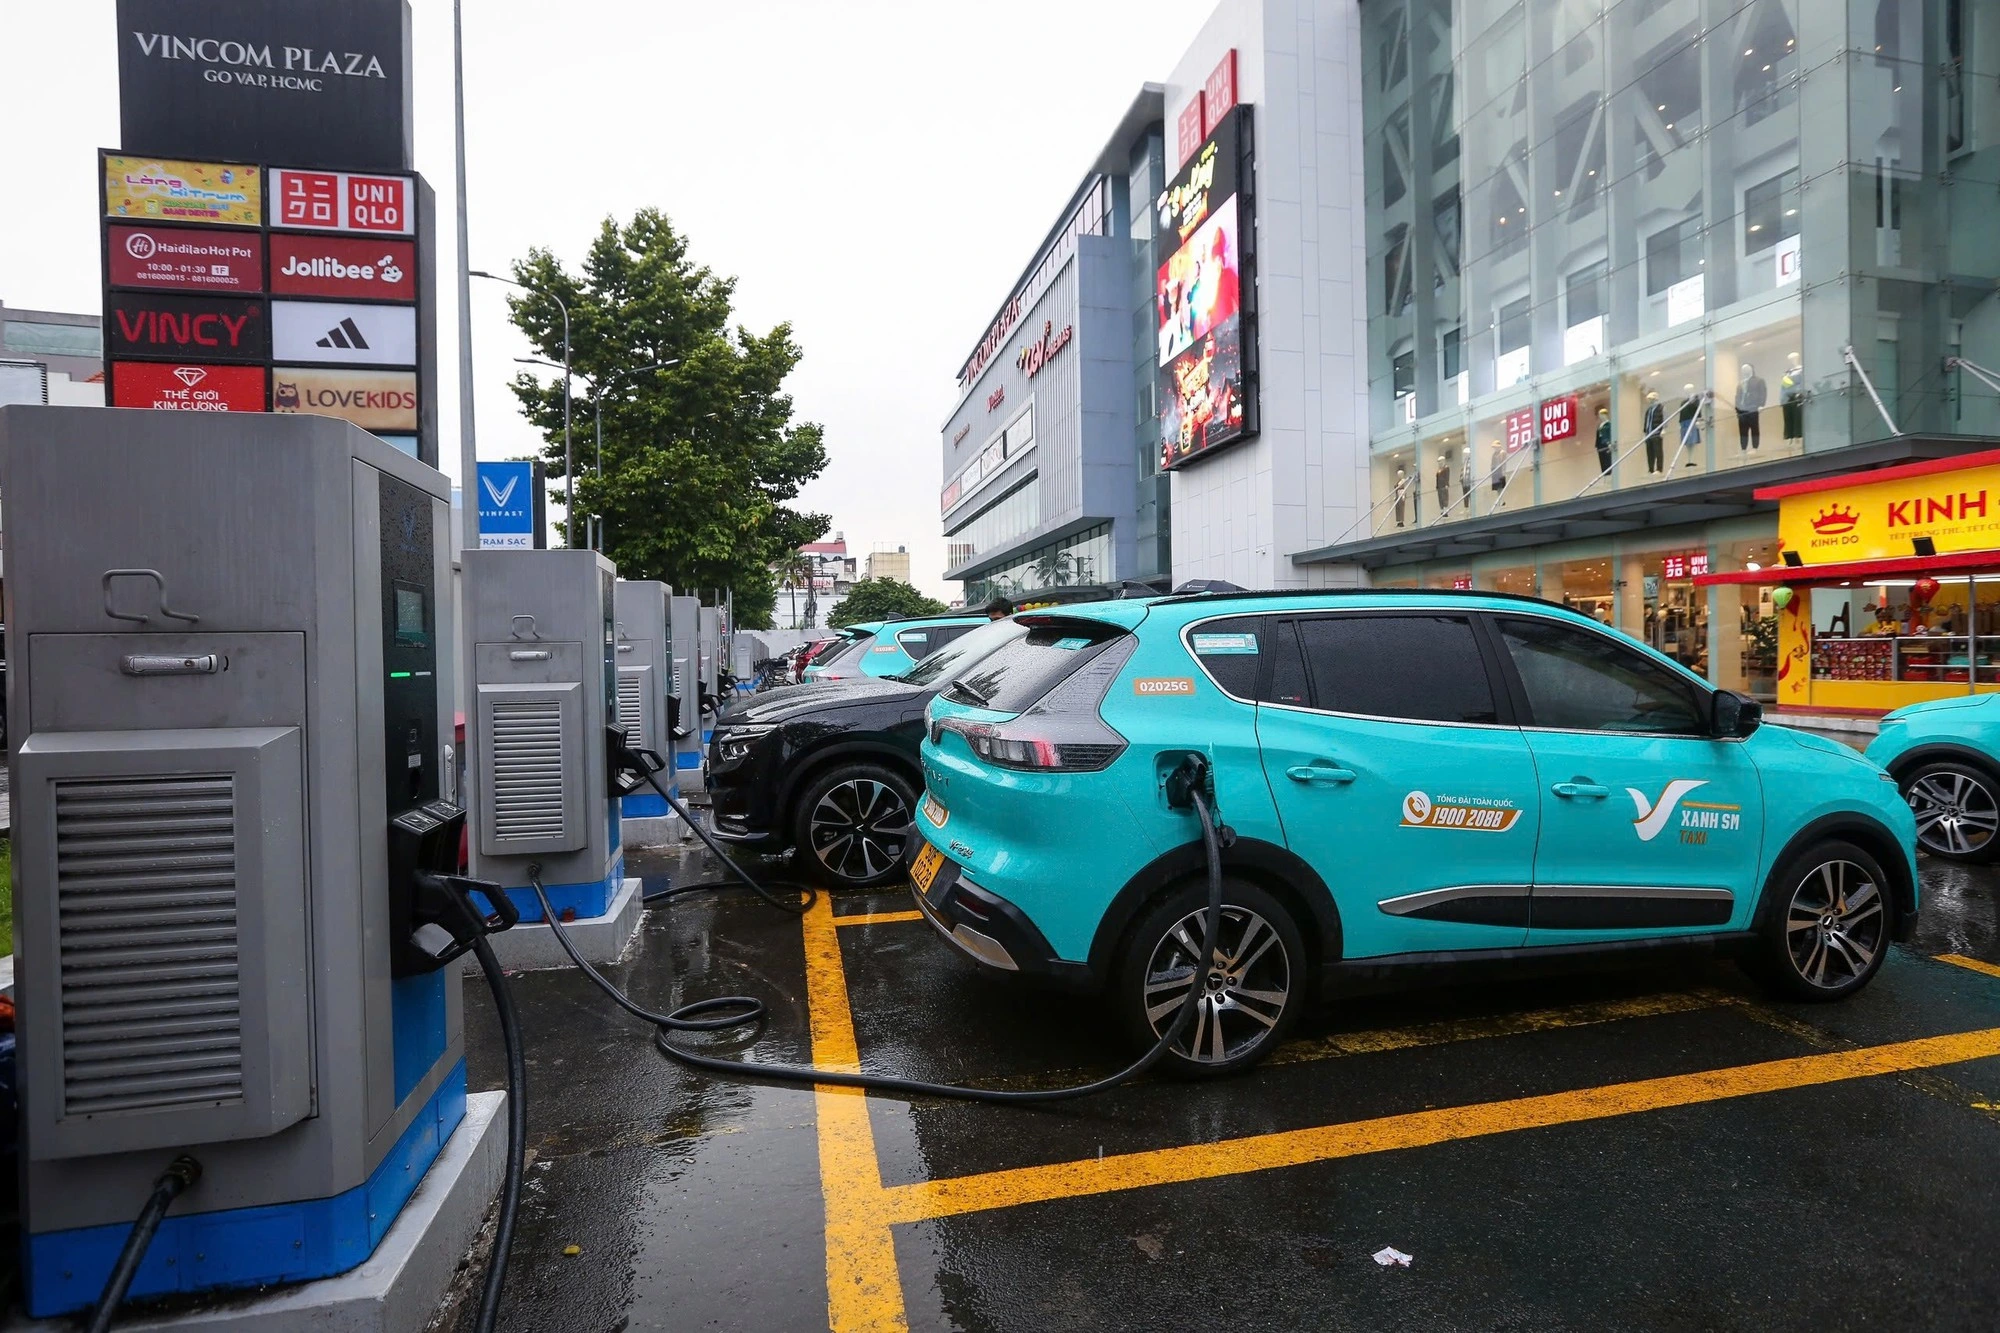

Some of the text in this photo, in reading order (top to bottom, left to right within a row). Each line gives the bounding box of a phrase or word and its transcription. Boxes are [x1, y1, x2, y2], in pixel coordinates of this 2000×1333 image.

[133, 31, 387, 79] VINCOM PLAZA
[204, 69, 232, 85] GO
[271, 76, 322, 92] HCMC
[1208, 63, 1226, 100] UNI
[1208, 86, 1229, 125] QLO
[1181, 103, 1197, 137] ユニ
[1181, 127, 1199, 160] クロ
[289, 178, 331, 197] ユニ
[353, 184, 394, 204] UNI
[287, 202, 332, 221] クロ
[354, 204, 397, 225] QLO
[157, 243, 252, 258] Haidilao Hot Pot
[147, 263, 173, 272] 10:00
[180, 265, 206, 273] 01:30
[215, 266, 226, 275] 1F
[281, 255, 374, 279] Jollibee
[115, 309, 248, 347] VINCY
[1025, 334, 1047, 379] CGV
[163, 387, 189, 400] THẾ
[306, 389, 416, 410] LOVEKIDS
[153, 401, 178, 410] KIM
[1543, 402, 1567, 422] UNI
[1509, 413, 1531, 433] ユニ
[1543, 418, 1570, 440] QLO
[1509, 429, 1531, 448] クロ
[1888, 490, 1987, 527] KINH
[1811, 537, 1838, 548] KINH
[1691, 556, 1708, 566] UNI
[1139, 681, 1189, 692] 02025G
[1472, 796, 1492, 806] TOÀN
[1432, 807, 1504, 828] 1900 2088
[1681, 810, 1740, 830] XANH SM
[1681, 830, 1707, 845] TAXI
